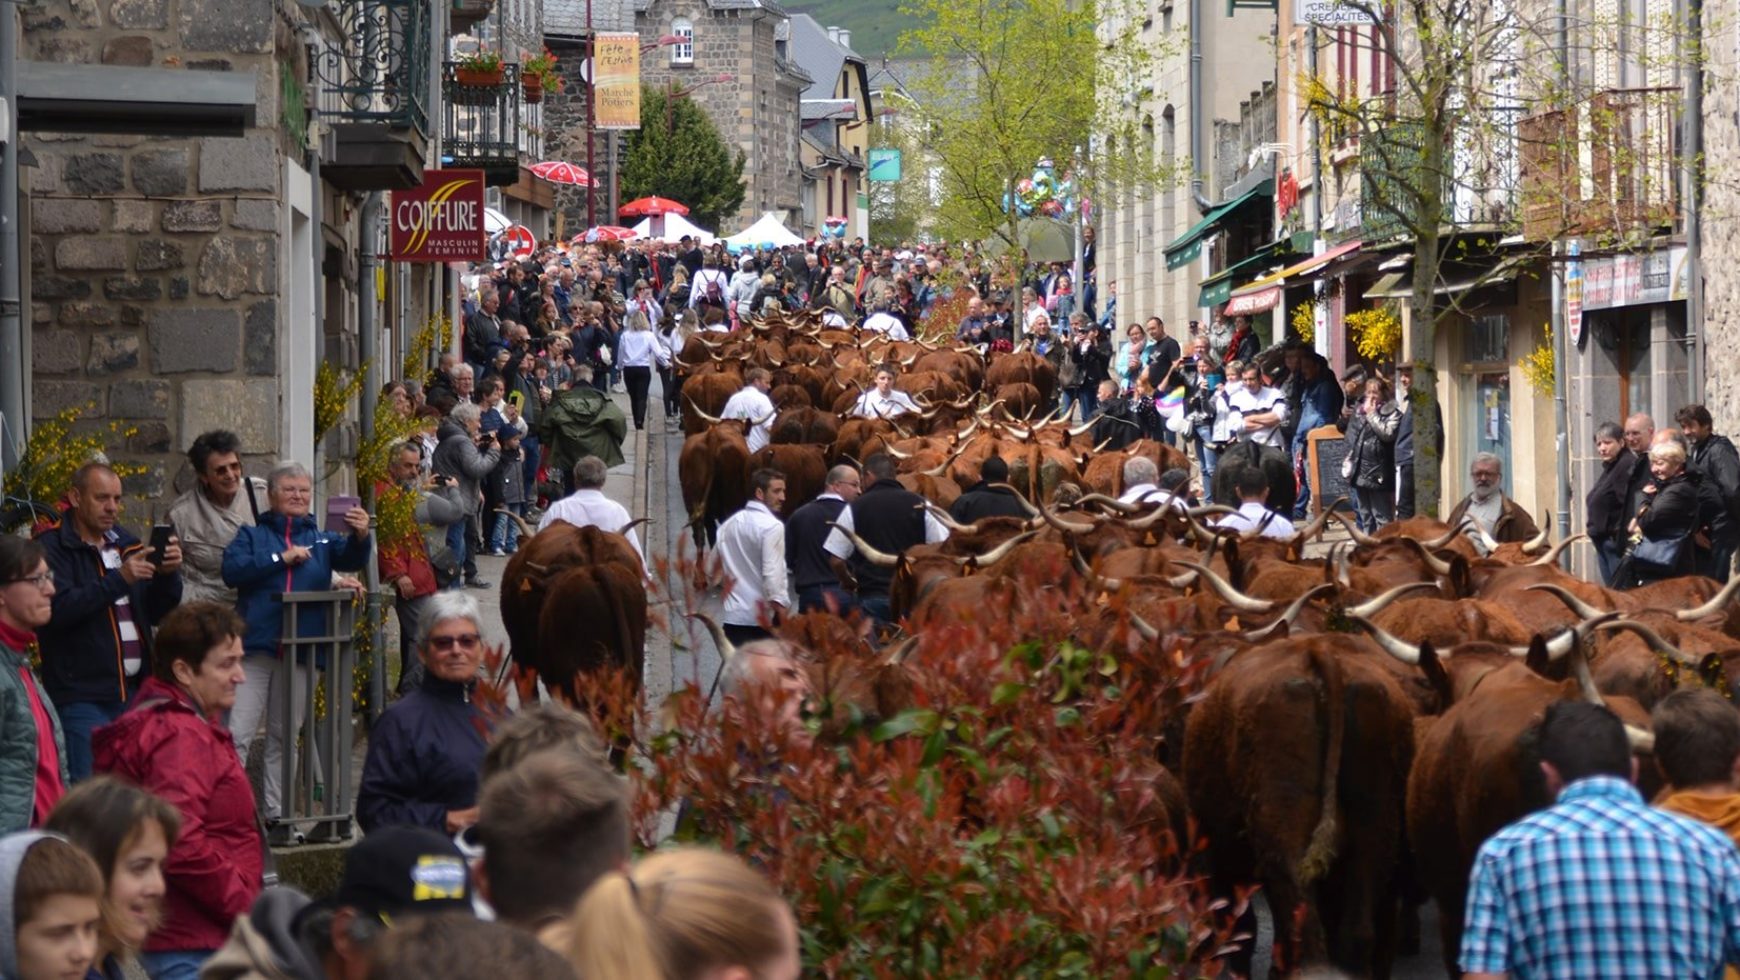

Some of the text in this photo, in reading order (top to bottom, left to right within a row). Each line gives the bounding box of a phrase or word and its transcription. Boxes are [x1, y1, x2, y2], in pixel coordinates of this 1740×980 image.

[601, 87, 634, 97] Marché
[601, 97, 634, 107] Potiers
[397, 201, 478, 232] COIFFURE
